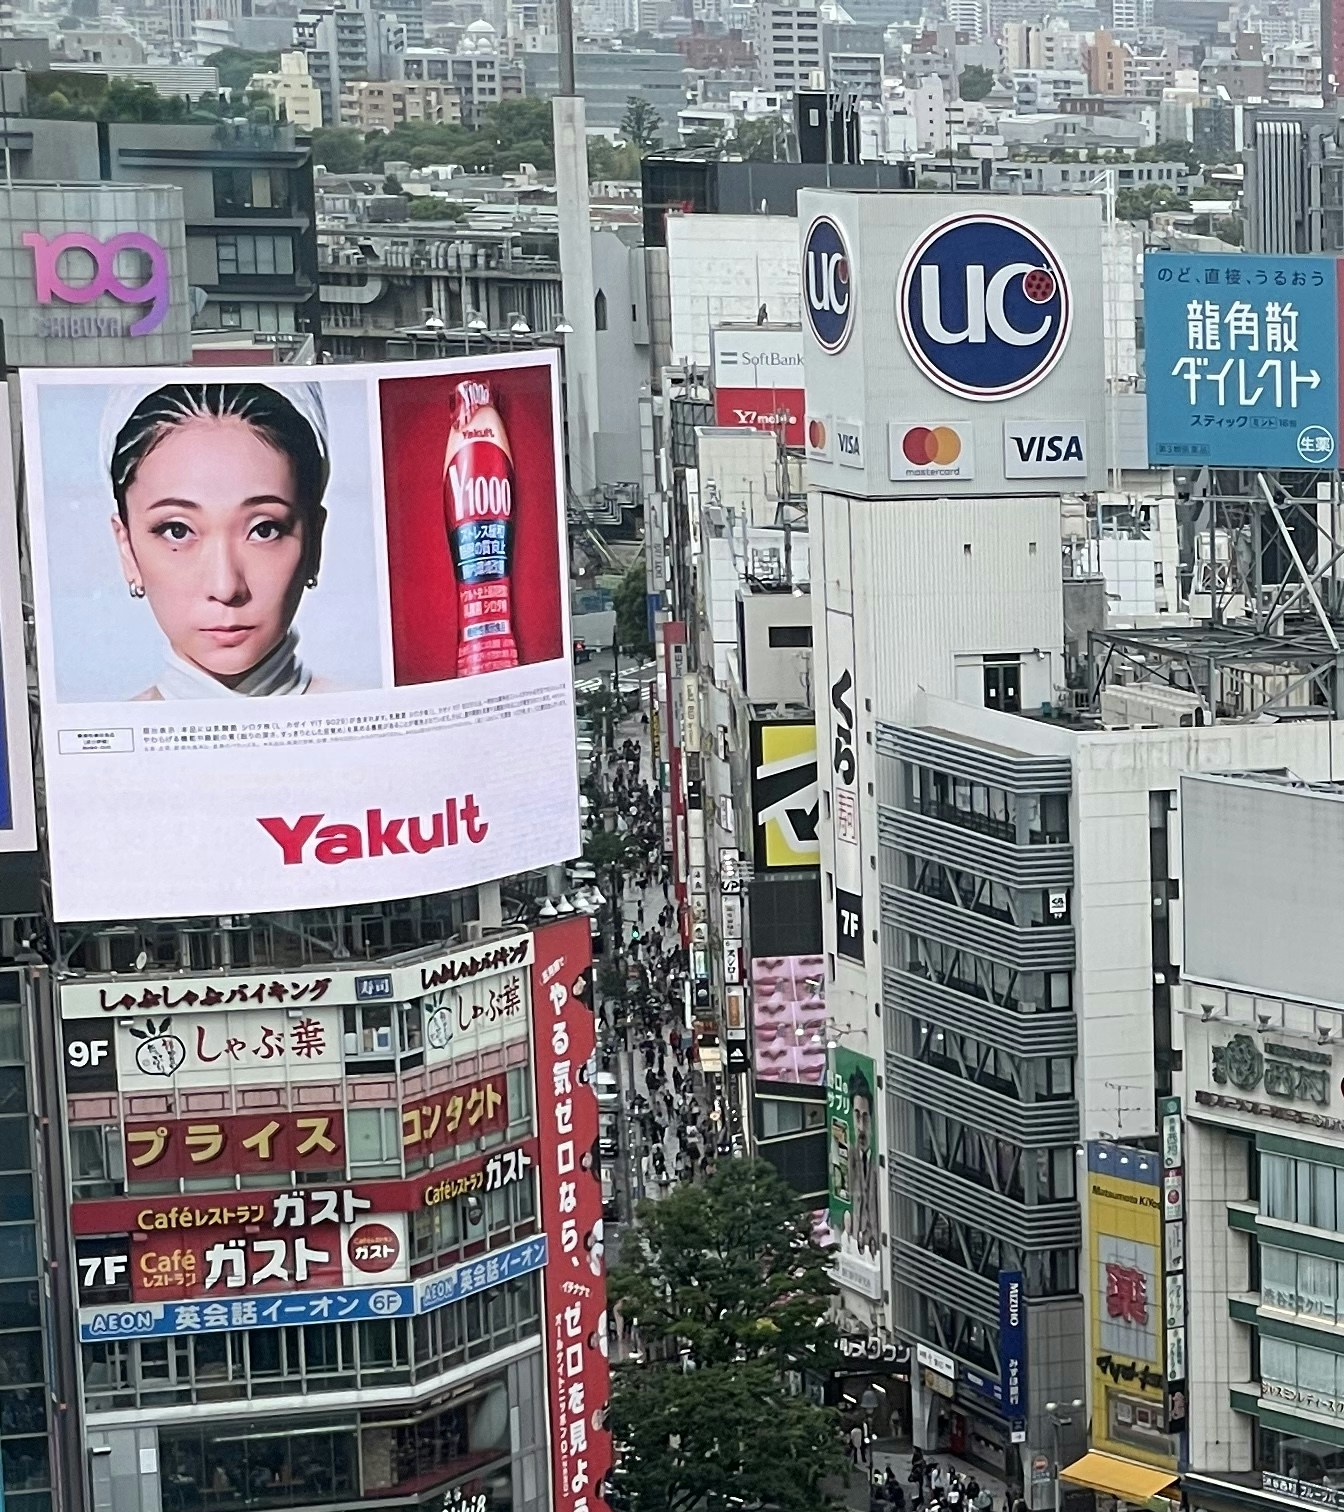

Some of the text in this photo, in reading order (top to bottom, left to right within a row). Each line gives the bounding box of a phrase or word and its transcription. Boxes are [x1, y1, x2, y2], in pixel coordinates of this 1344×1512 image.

[22, 231, 169, 336] 109
[1157, 267, 1325, 287] のど、直接、うるおう
[38, 314, 122, 338] SHIBUYA
[1186, 300, 1299, 352] 龍角散
[742, 351, 805, 366] SoftBank
[1171, 356, 1322, 408] ダイレクト
[1191, 414, 1247, 427] スティック
[837, 432, 861, 456] VISA
[1009, 435, 1084, 462] VISA
[905, 466, 960, 476] mastercard
[448, 463, 511, 520] Y1000
[257, 793, 489, 866] Yakult
[840, 909, 859, 938] 7F
[99, 977, 332, 1012] しゃぶしゃぶバイキング
[458, 976, 521, 1031] しゃぶ葉
[68, 1040, 109, 1068] 9F
[196, 1017, 326, 1062] しゃぶ葉
[402, 1083, 502, 1146] コンタクト
[549, 981, 580, 1268] やる気ゼロなら、
[127, 1117, 336, 1167] プライス
[485, 1148, 531, 1192] ガスト
[272, 1189, 371, 1228] ガスト
[140, 1249, 196, 1274] Café
[204, 1237, 330, 1290] ガスト
[354, 1244, 395, 1261] ガスト
[78, 1255, 128, 1287] 7F
[143, 1273, 196, 1288] レストラン
[372, 1292, 399, 1310] 6F
[423, 1280, 453, 1307] AEON
[91, 1311, 153, 1333] AEON
